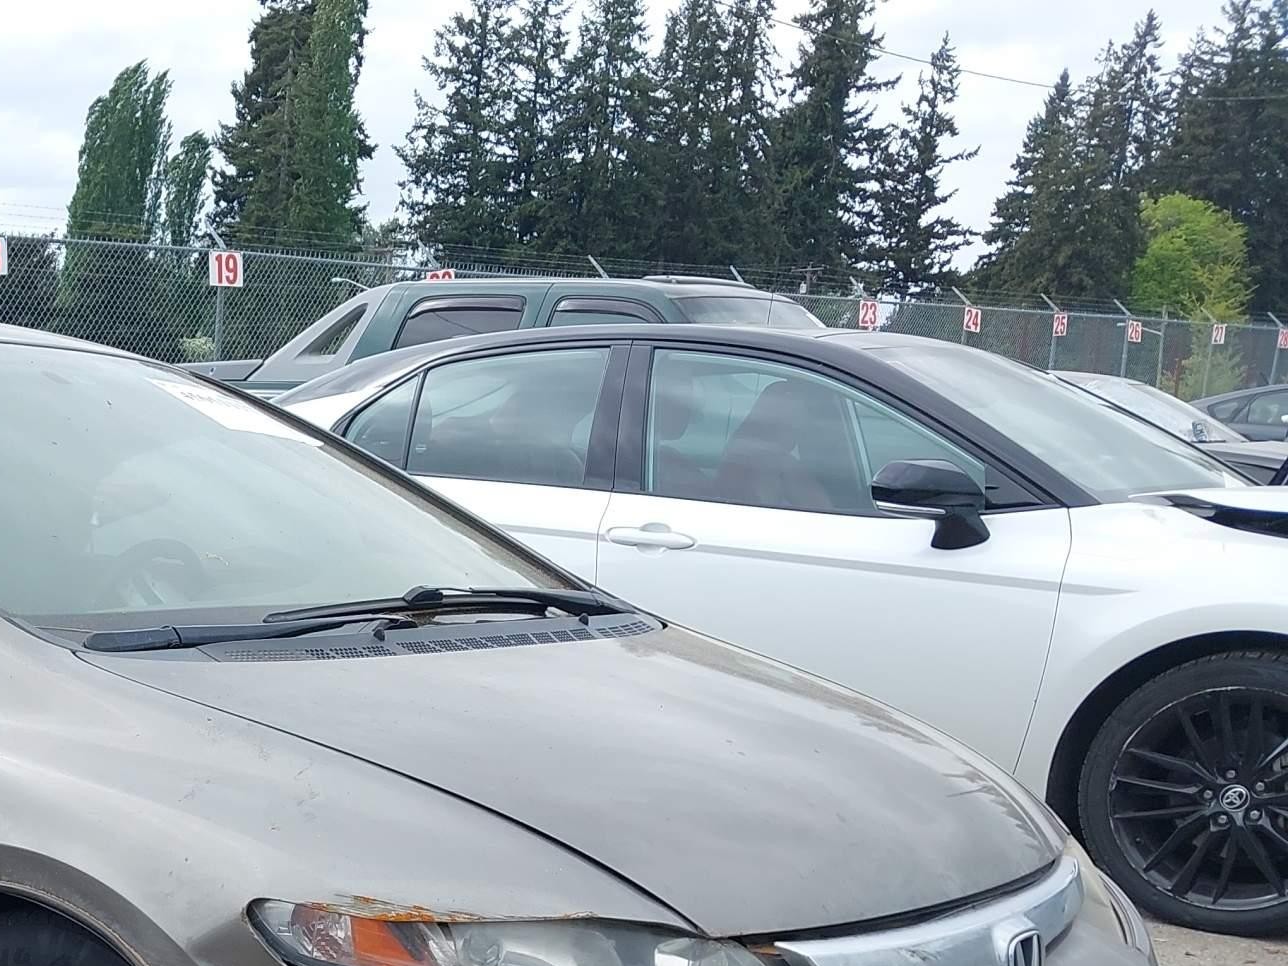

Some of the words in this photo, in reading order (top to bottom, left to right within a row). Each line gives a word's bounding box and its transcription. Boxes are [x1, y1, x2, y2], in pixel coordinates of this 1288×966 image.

[215, 253, 238, 285] 19
[861, 302, 877, 324] 23
[965, 309, 979, 331] 24
[1054, 316, 1066, 335] 25
[1129, 322, 1140, 341] 26
[1214, 326, 1224, 343] 27
